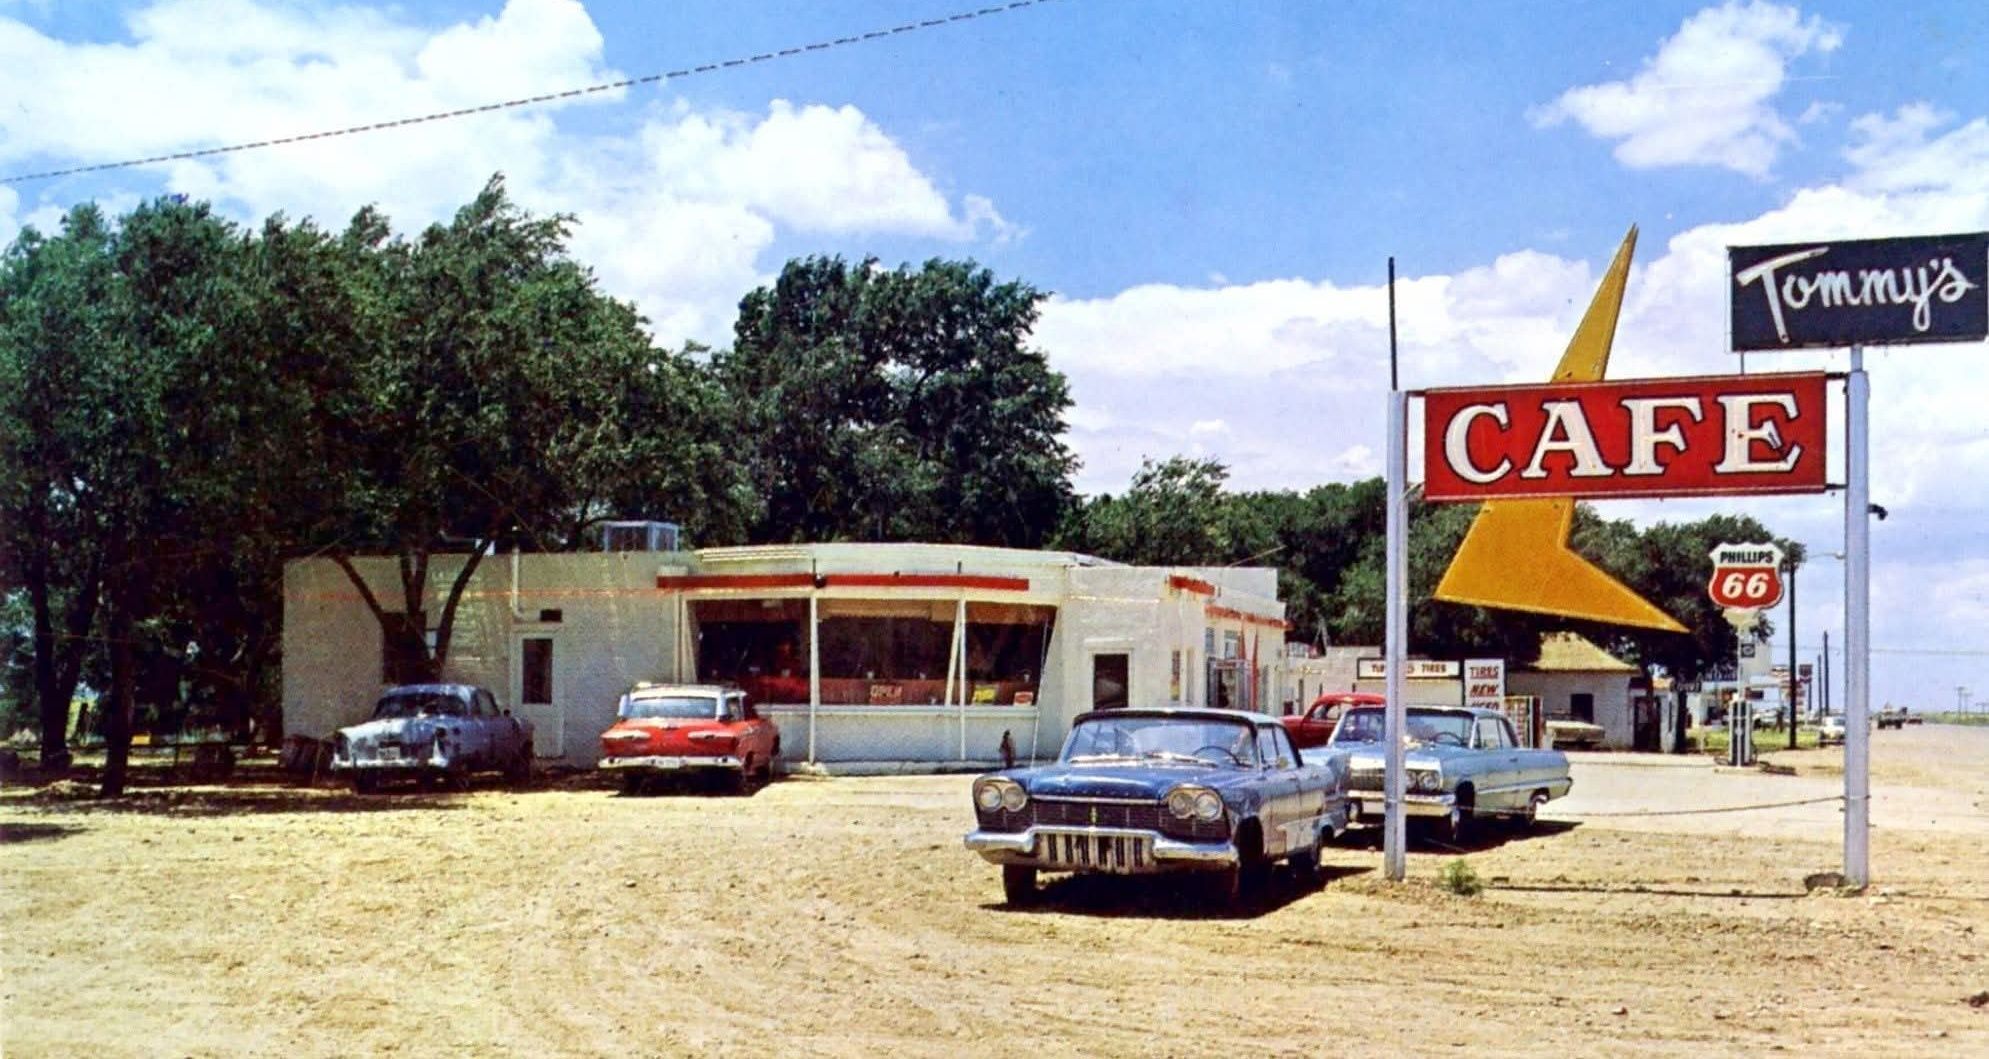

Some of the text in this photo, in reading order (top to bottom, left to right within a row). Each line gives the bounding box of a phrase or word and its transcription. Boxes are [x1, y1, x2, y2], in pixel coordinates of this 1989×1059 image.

[1736, 247, 1979, 344] Tommy's
[1443, 394, 1802, 485] CAFE
[1720, 551, 1774, 564] PHILLIPS
[1722, 572, 1770, 599] 66
[1470, 666, 1499, 678] TIRES
[1470, 684, 1500, 697] NEW
